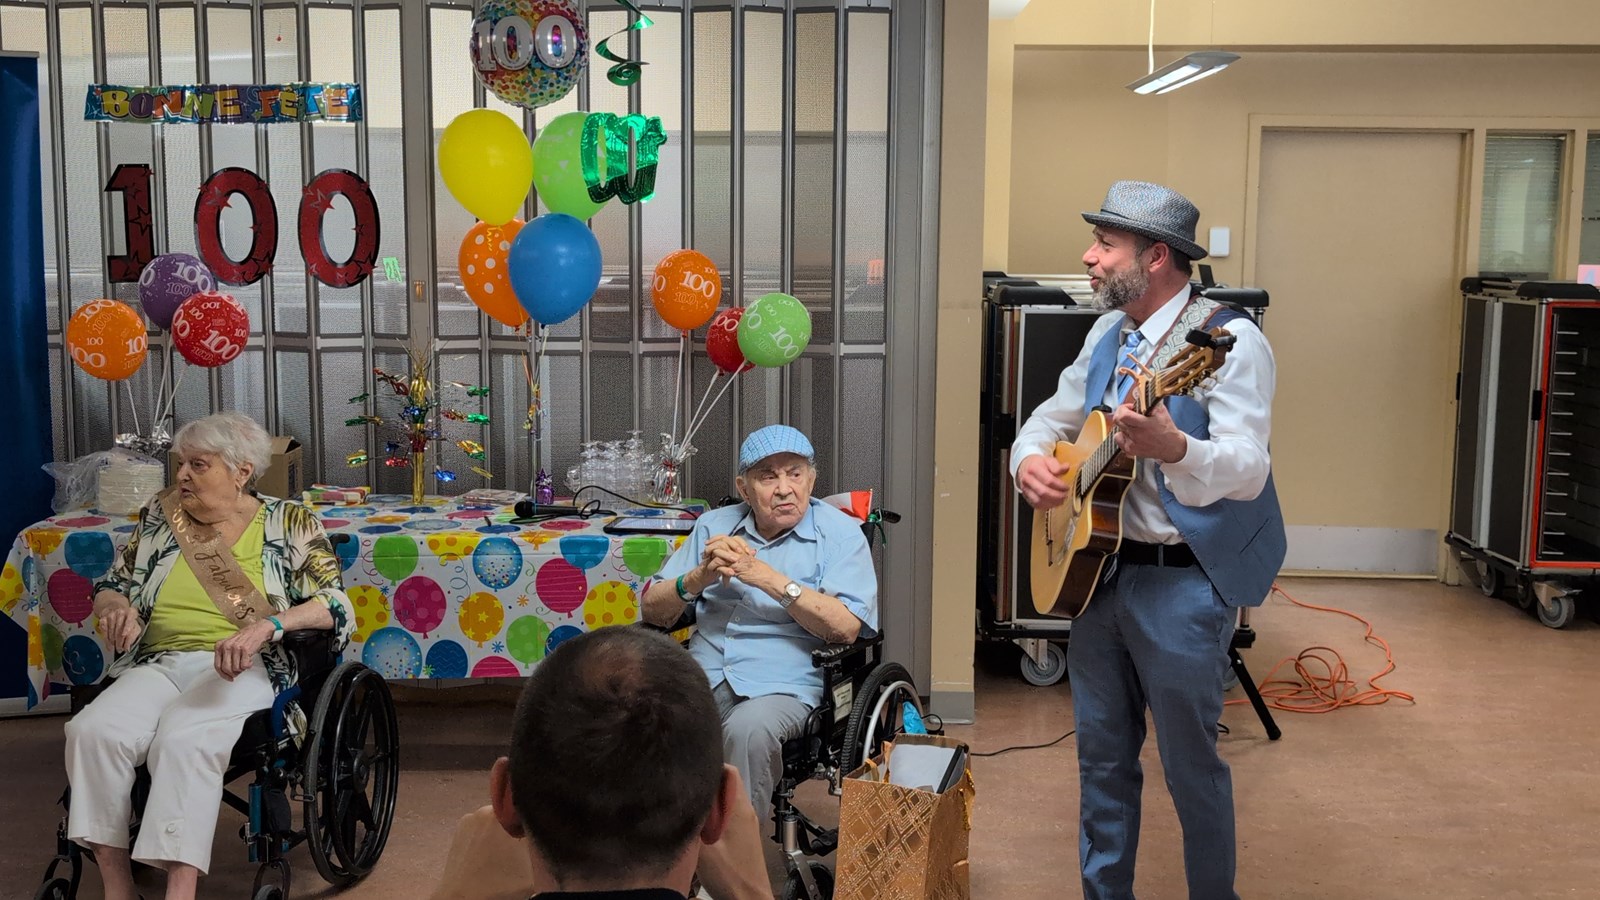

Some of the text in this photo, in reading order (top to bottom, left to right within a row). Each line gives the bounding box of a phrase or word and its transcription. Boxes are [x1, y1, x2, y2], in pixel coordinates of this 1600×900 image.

[474, 15, 577, 71] 100
[101, 88, 241, 119] BONNE
[104, 163, 381, 288] 100
[679, 271, 715, 298] 100
[189, 307, 205, 320] 100
[69, 342, 107, 368] 100
[87, 336, 104, 346] 100
[125, 331, 148, 356] 100
[200, 329, 240, 360] 100
[769, 325, 799, 358] 100
